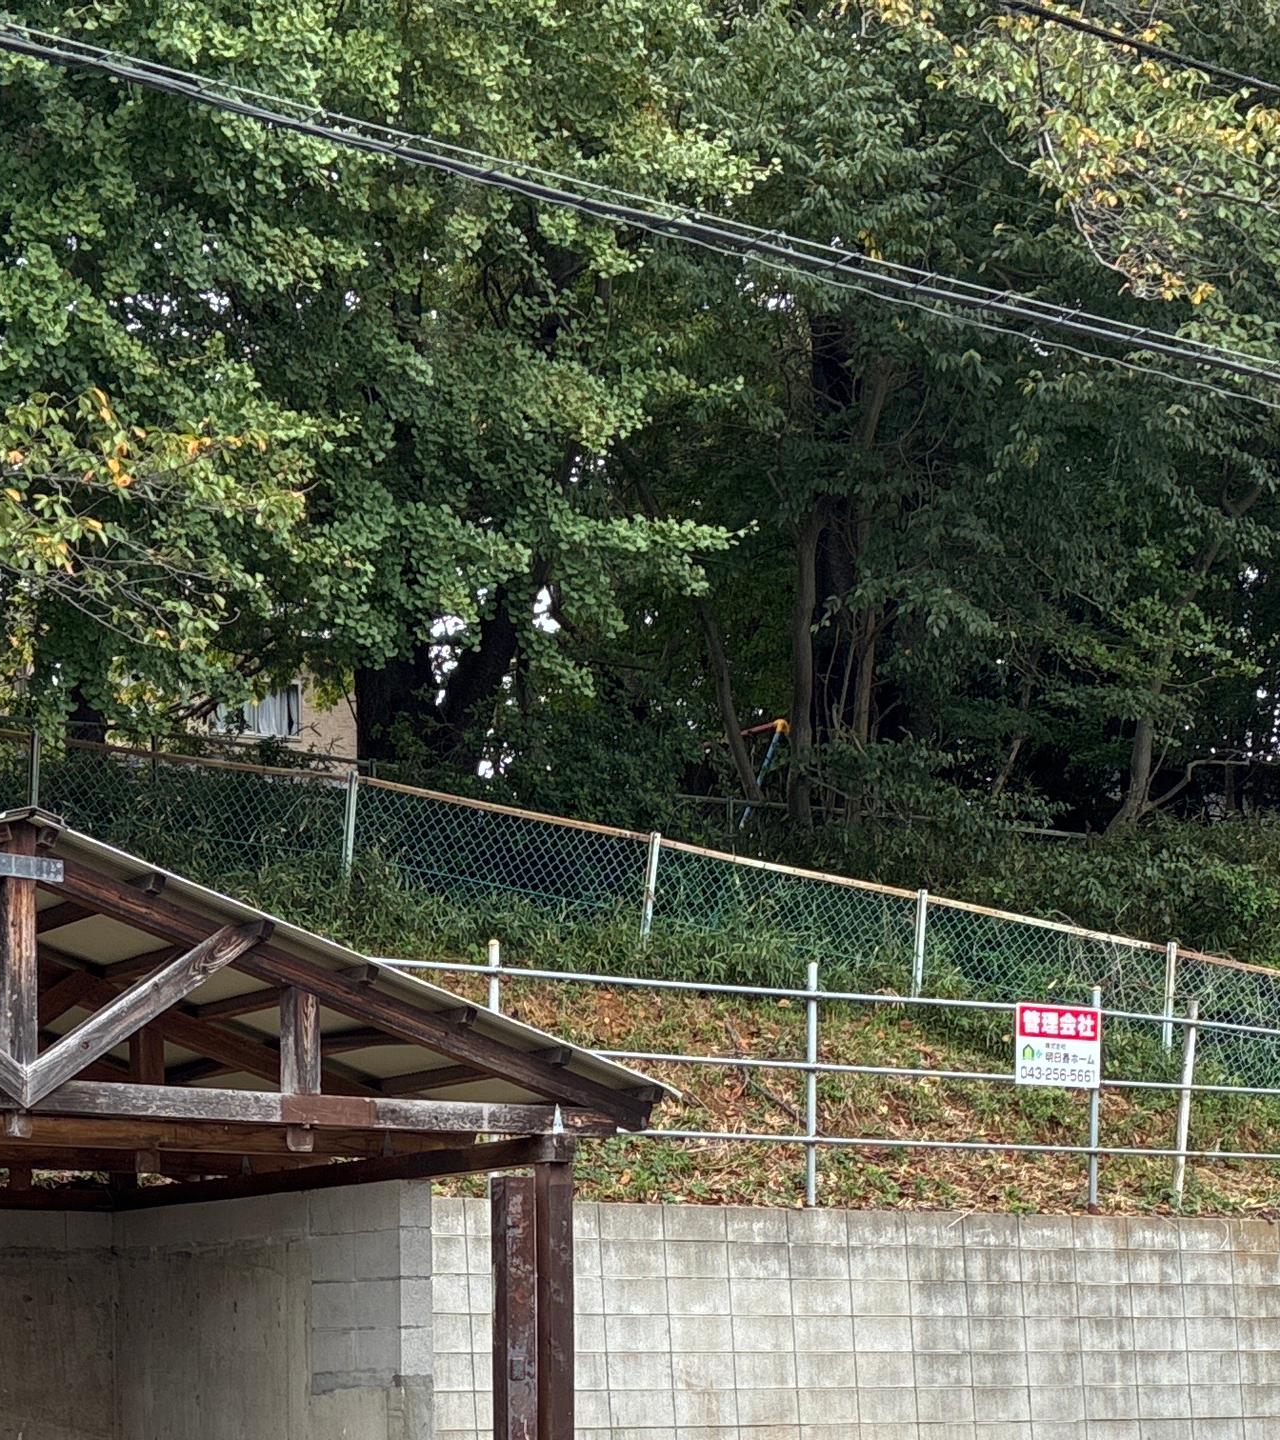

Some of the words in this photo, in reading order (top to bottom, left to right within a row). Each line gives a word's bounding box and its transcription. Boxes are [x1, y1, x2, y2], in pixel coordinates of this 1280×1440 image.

[1023, 1010, 1095, 1037] 管理会社
[1020, 1065, 1095, 1083] 043-256-5661
